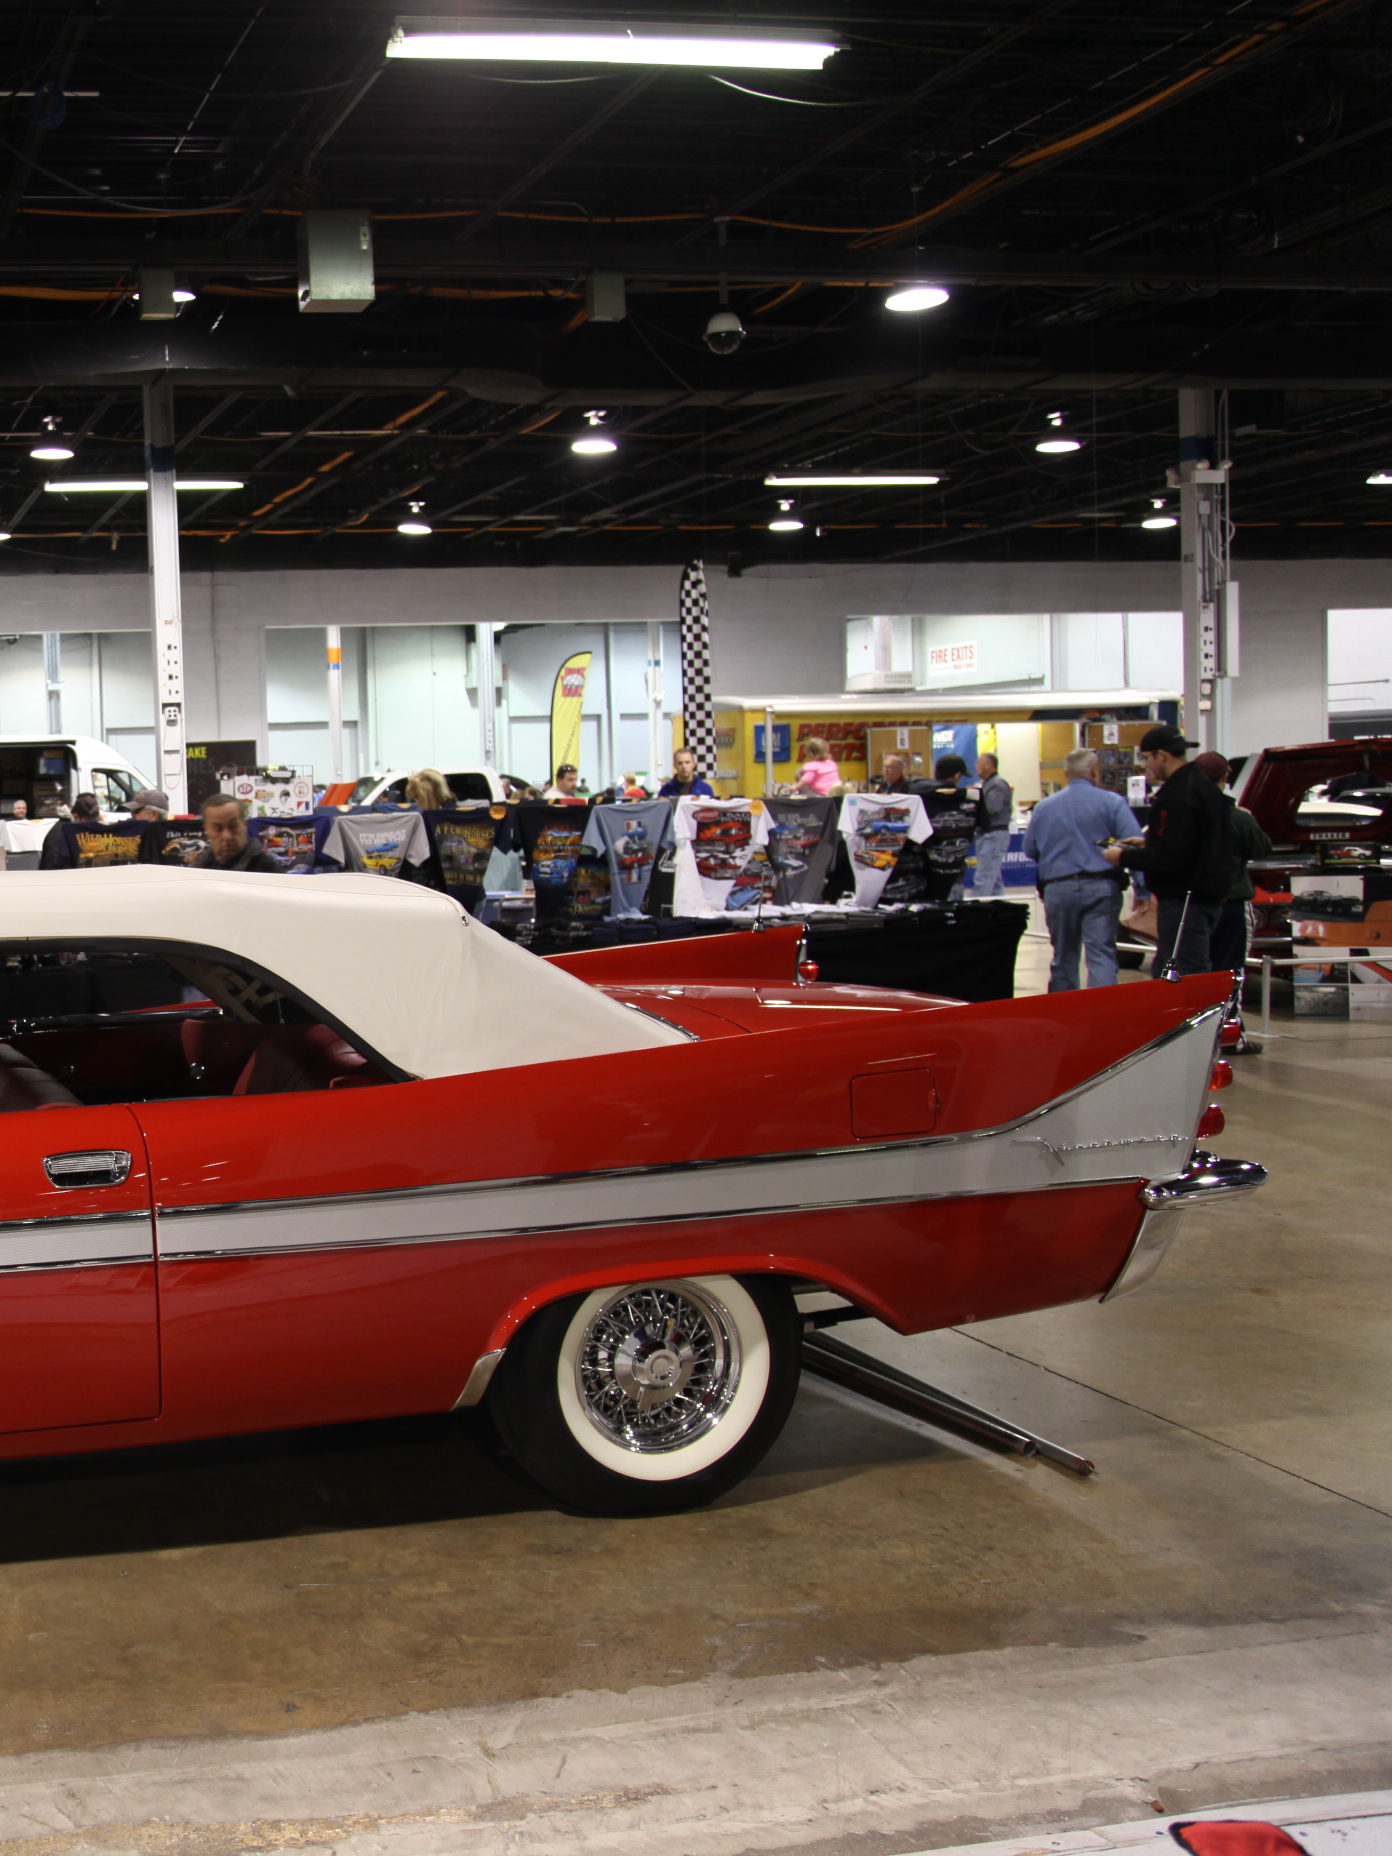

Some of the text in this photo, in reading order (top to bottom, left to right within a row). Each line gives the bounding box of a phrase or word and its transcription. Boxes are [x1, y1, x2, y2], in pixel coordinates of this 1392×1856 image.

[930, 645, 974, 665] FIRE EXITS
[797, 742, 867, 762] PRTS
[239, 785, 253, 793] STP
[76, 831, 142, 848] WILD HORSES
[376, 829, 407, 839] GREAT
[388, 834, 407, 843] THE
[464, 827, 496, 840] HORSES
